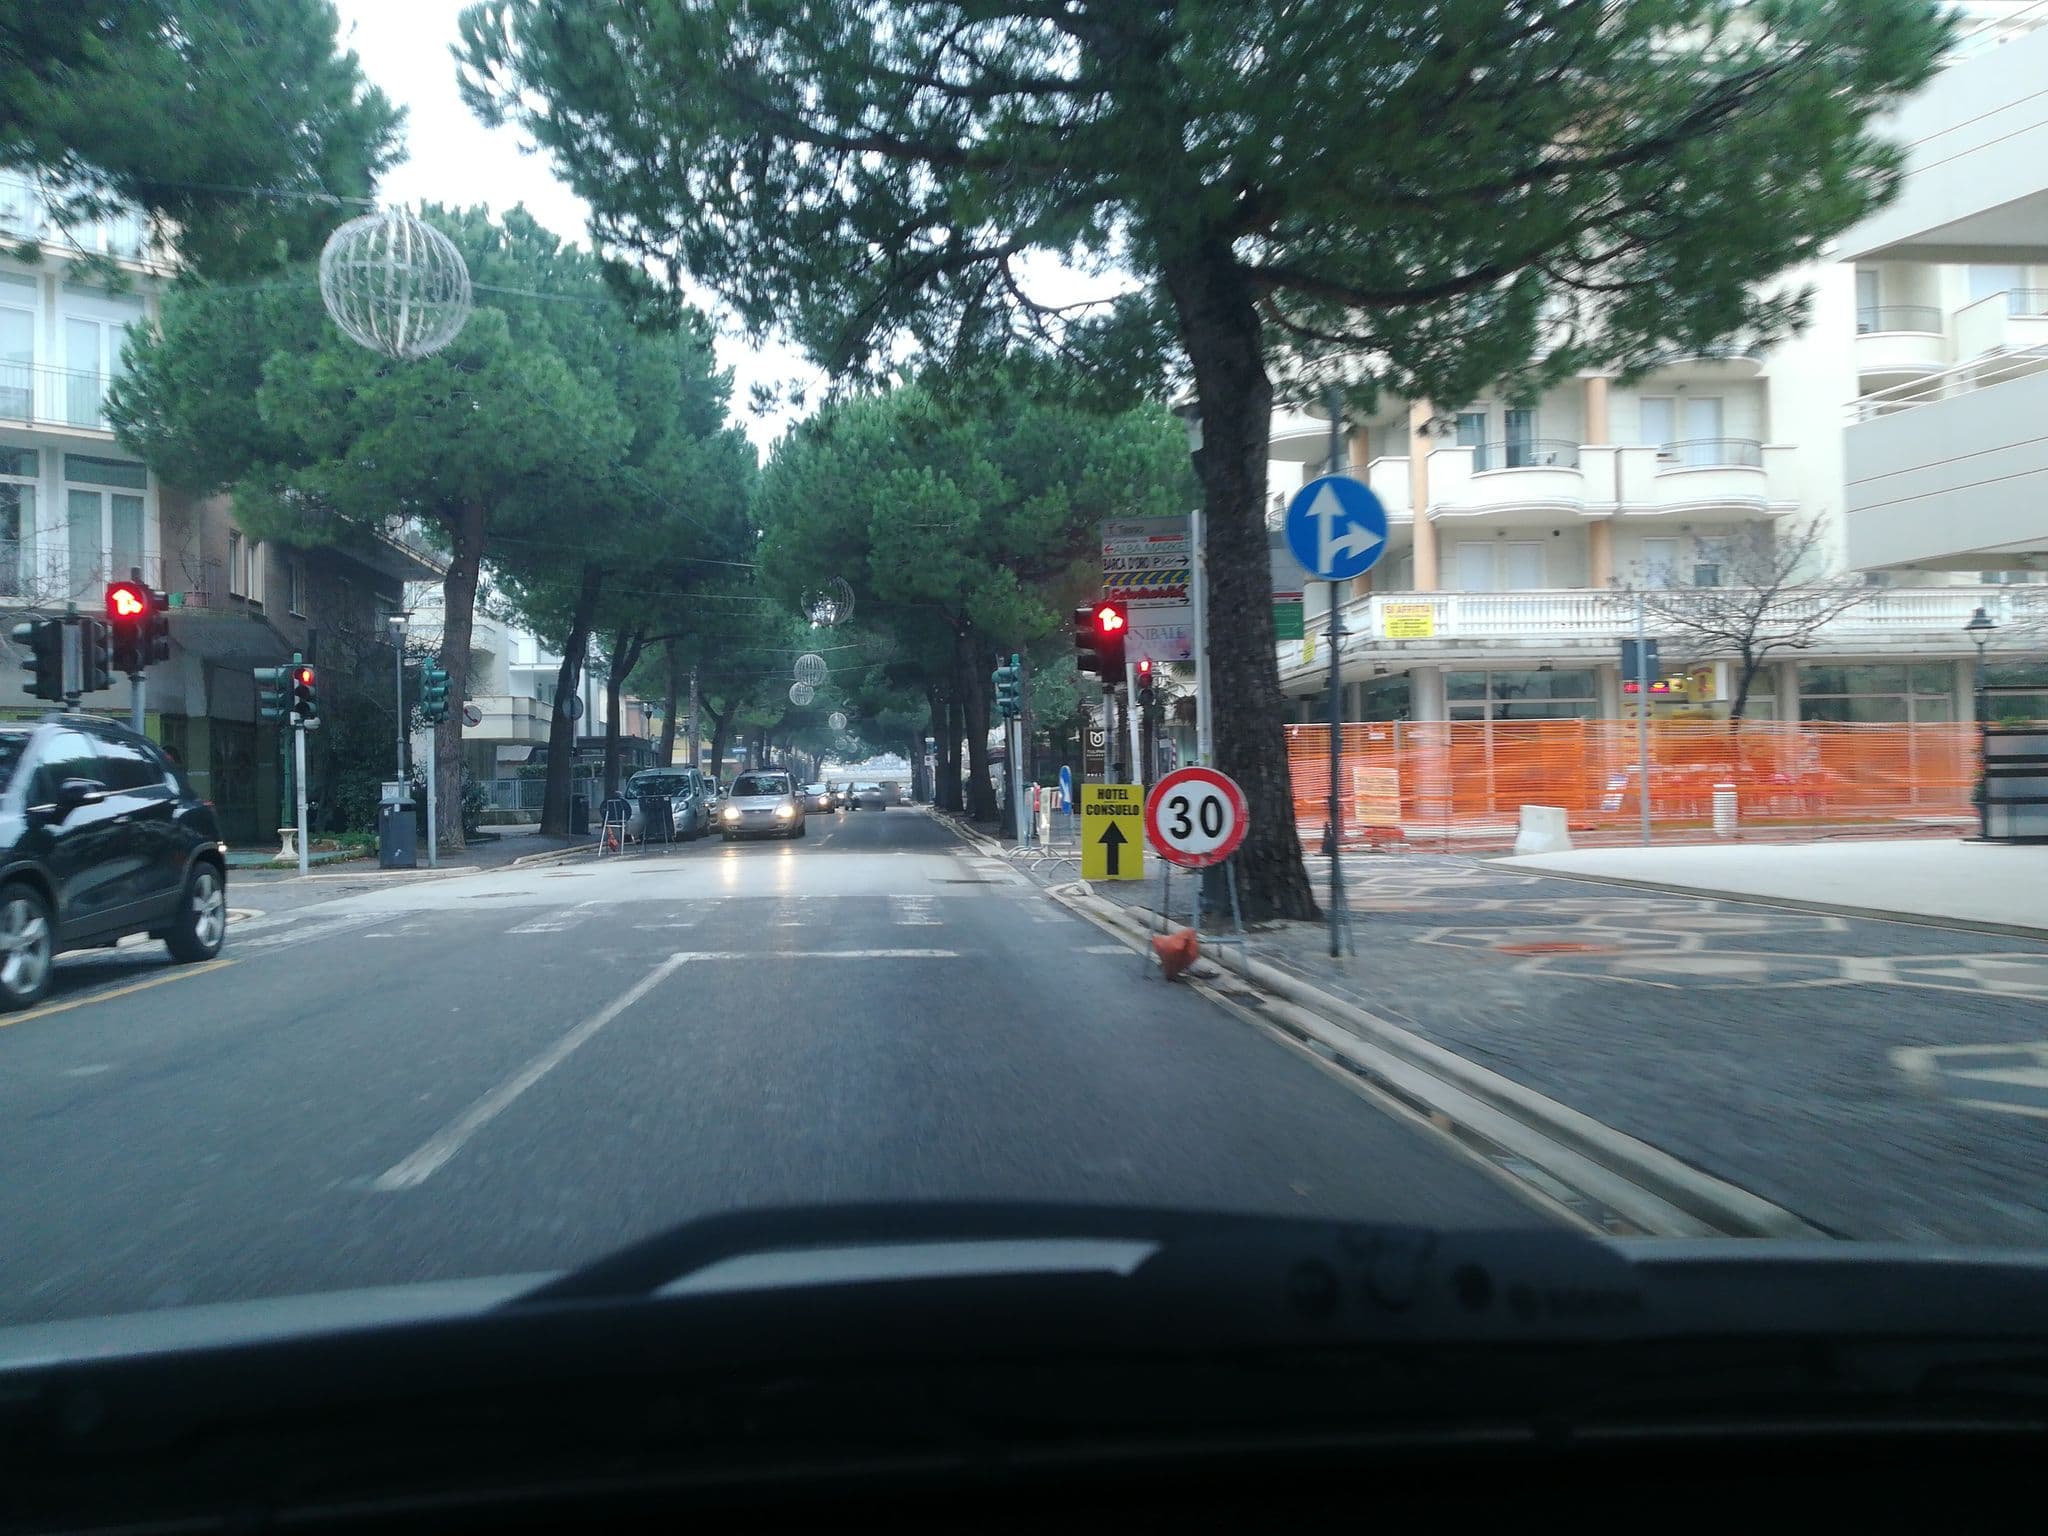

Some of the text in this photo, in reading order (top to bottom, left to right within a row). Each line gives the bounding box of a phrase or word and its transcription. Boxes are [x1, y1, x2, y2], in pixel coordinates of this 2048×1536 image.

[1097, 788, 1129, 800] HOTEL
[1086, 804, 1140, 816] CONSUELO
[1168, 795, 1223, 840] 30
